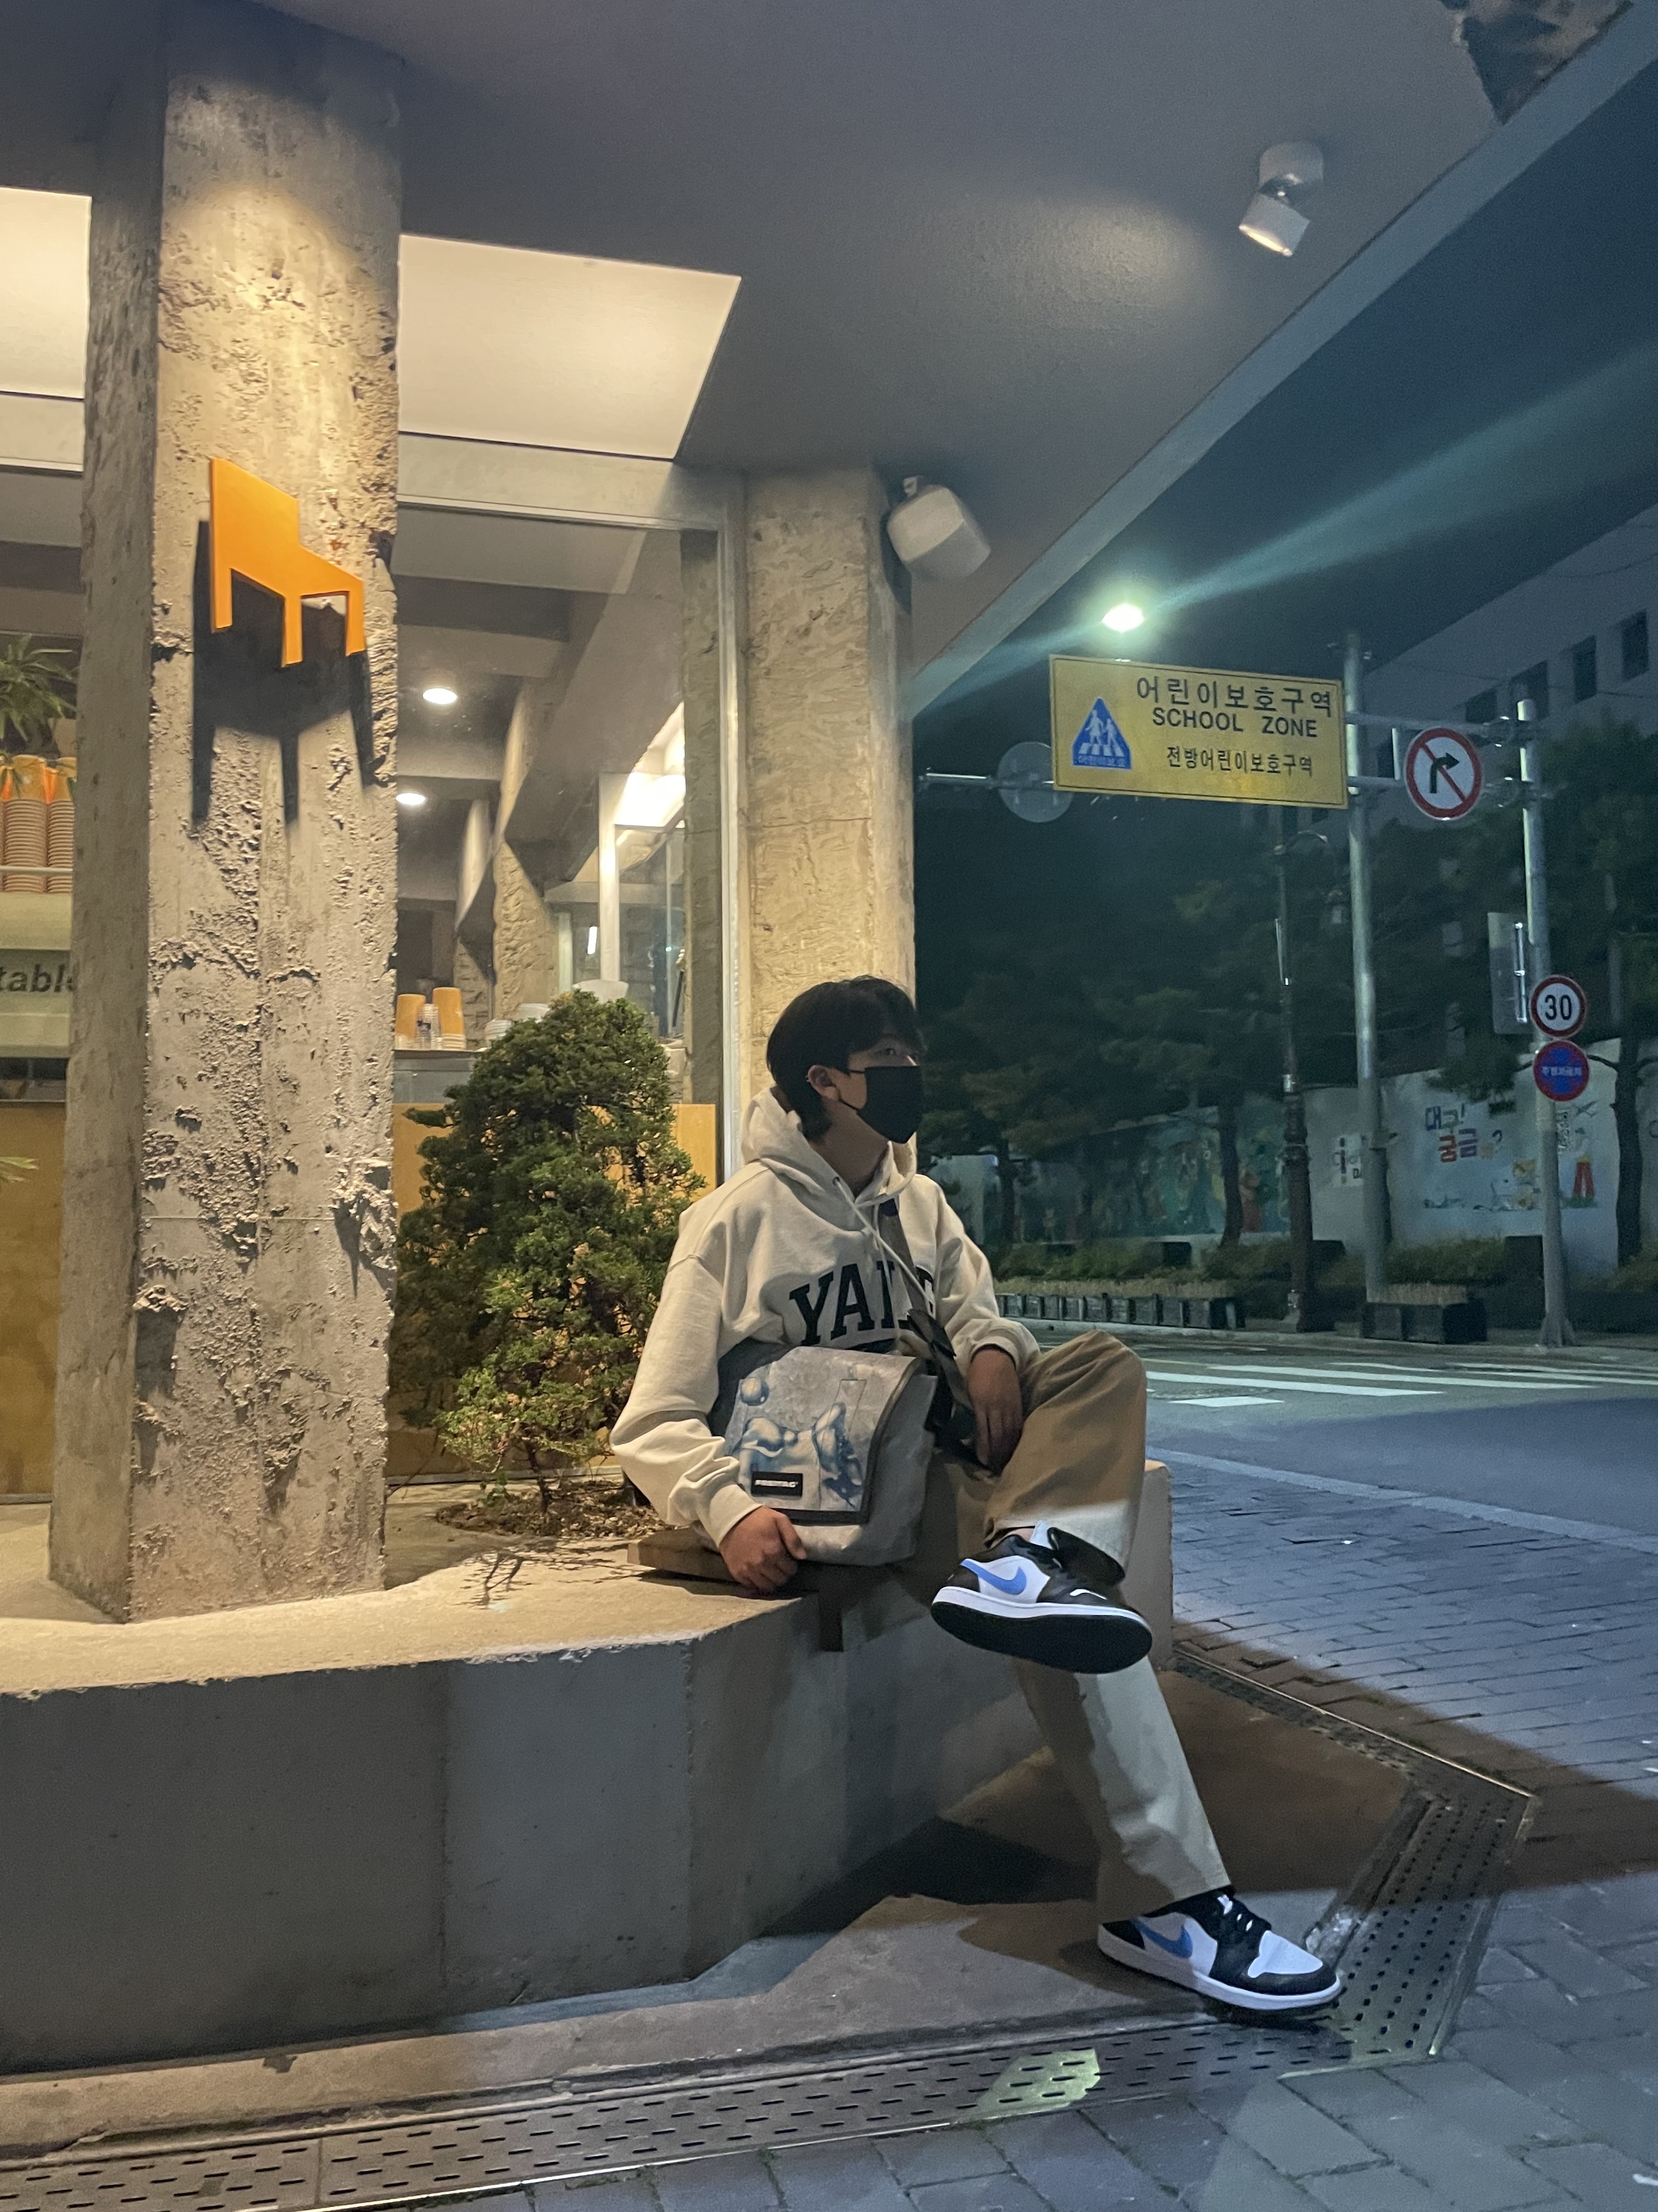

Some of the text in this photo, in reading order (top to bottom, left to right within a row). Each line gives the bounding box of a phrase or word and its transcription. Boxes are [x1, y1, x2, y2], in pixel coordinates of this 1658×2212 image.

[1137, 676, 1331, 718] 어린이보호구역
[1152, 707, 1317, 737] SCHOOL ZONE
[1167, 746, 1312, 777] 전방어린이보호구역
[1544, 995, 1572, 1020] 30
